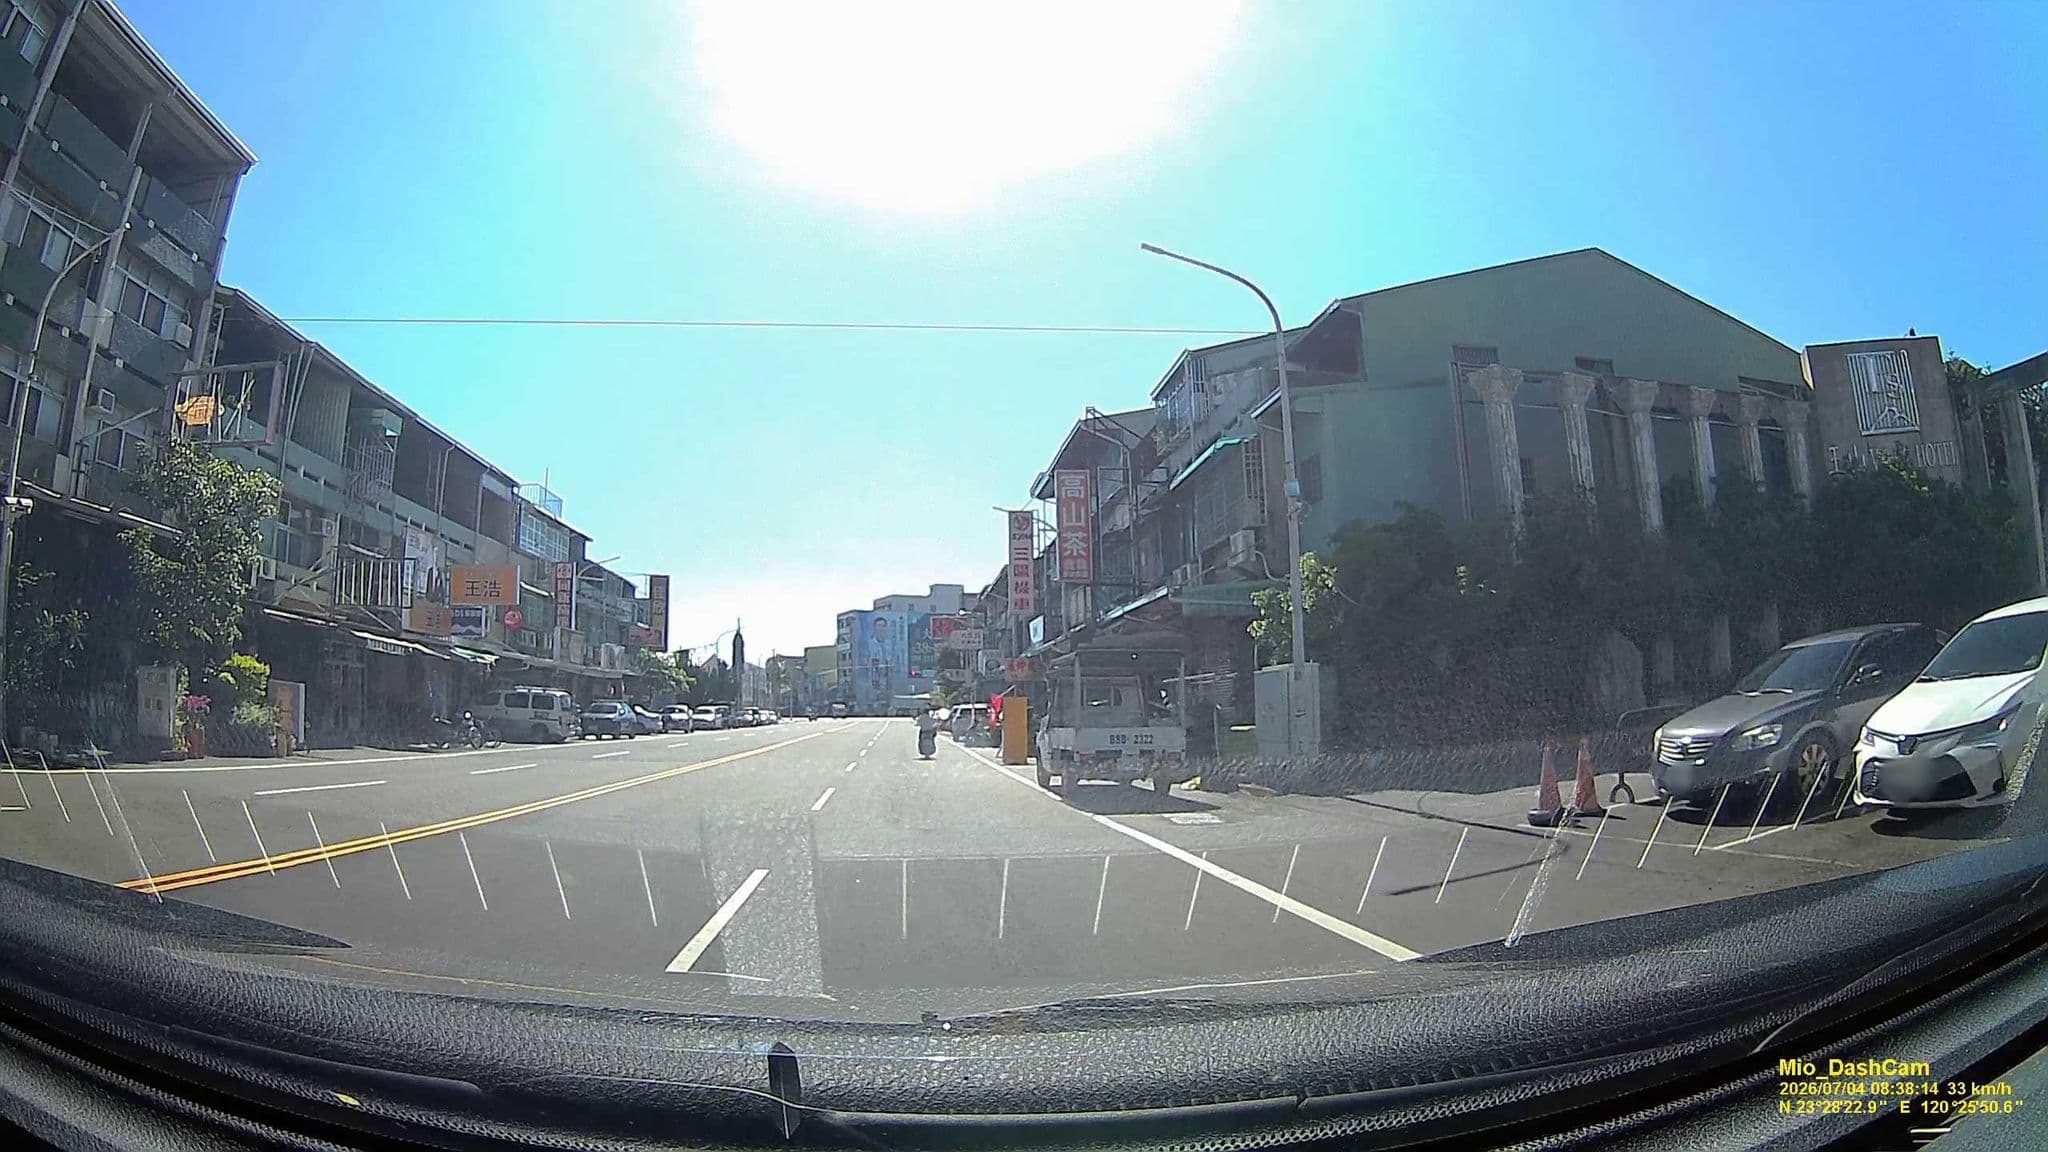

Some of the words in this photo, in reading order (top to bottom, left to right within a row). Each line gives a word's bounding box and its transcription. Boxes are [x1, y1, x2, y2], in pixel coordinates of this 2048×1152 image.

[1059, 475, 1089, 557] 高山茶
[464, 579, 502, 598] 王浩
